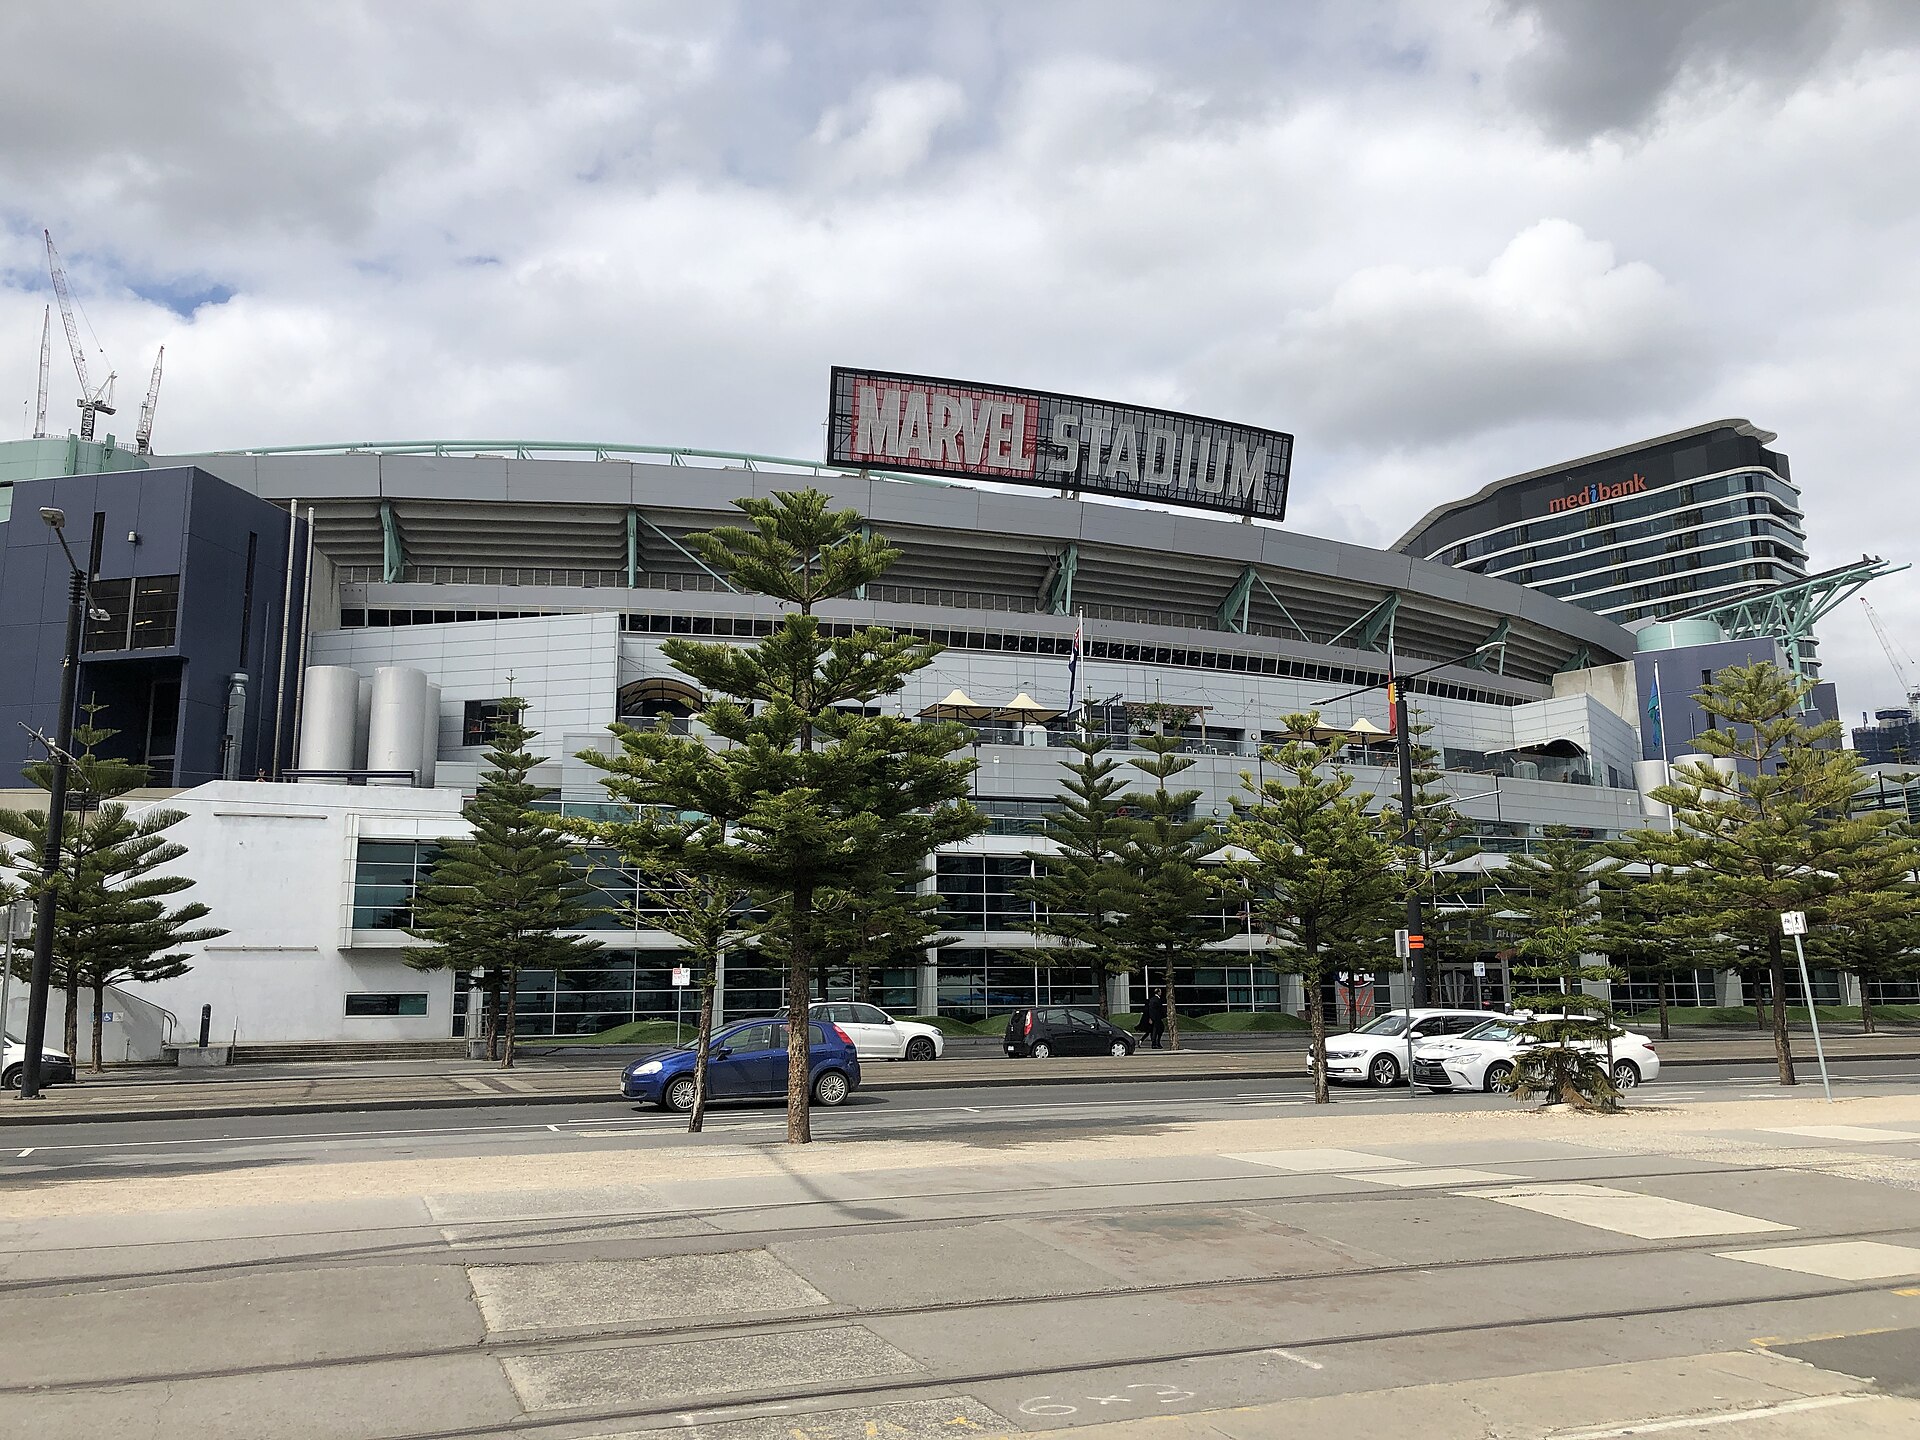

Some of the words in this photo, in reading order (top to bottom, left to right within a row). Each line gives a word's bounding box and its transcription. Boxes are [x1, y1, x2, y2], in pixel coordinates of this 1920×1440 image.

[857, 384, 1033, 471] MARVEL
[1048, 412, 1267, 501] STADIUM
[1549, 472, 1648, 513] medibank
